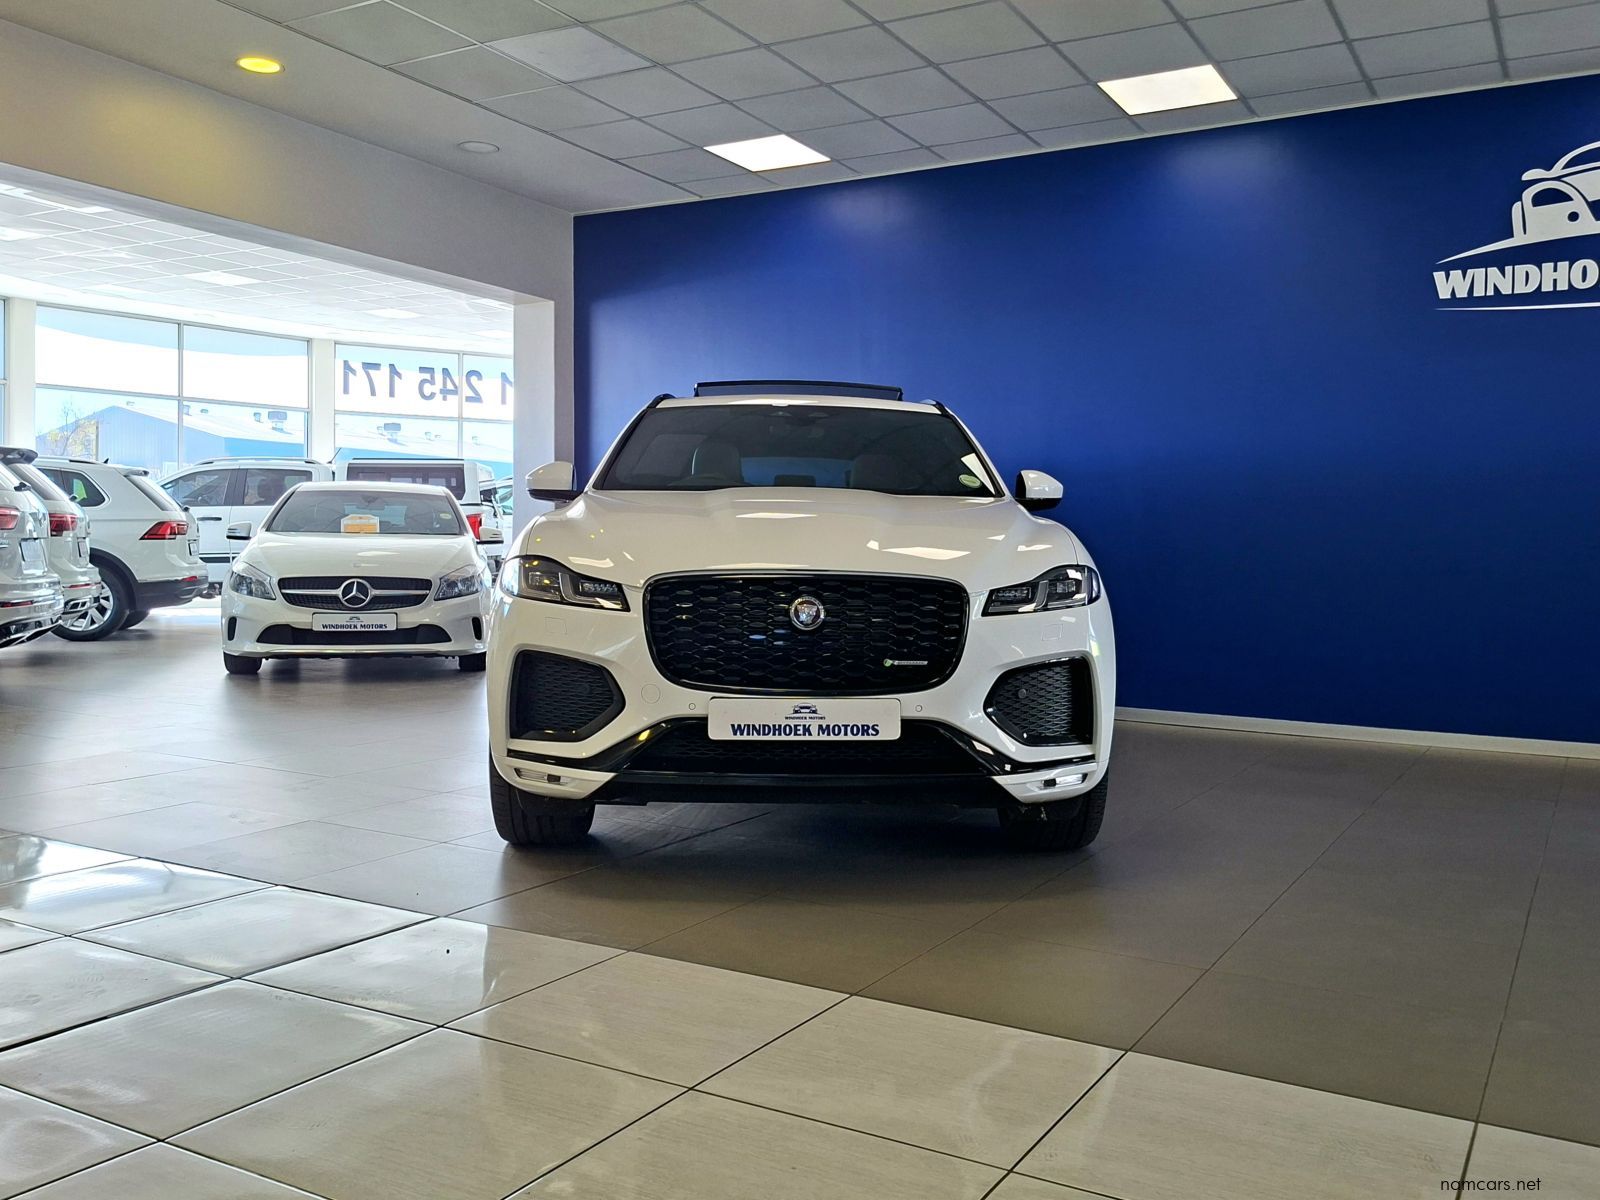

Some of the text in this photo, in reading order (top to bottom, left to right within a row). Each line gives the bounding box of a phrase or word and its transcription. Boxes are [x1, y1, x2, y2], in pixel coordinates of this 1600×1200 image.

[1433, 259, 1600, 299] WINDHO
[730, 724, 880, 736] WINDHOEK MOTORS
